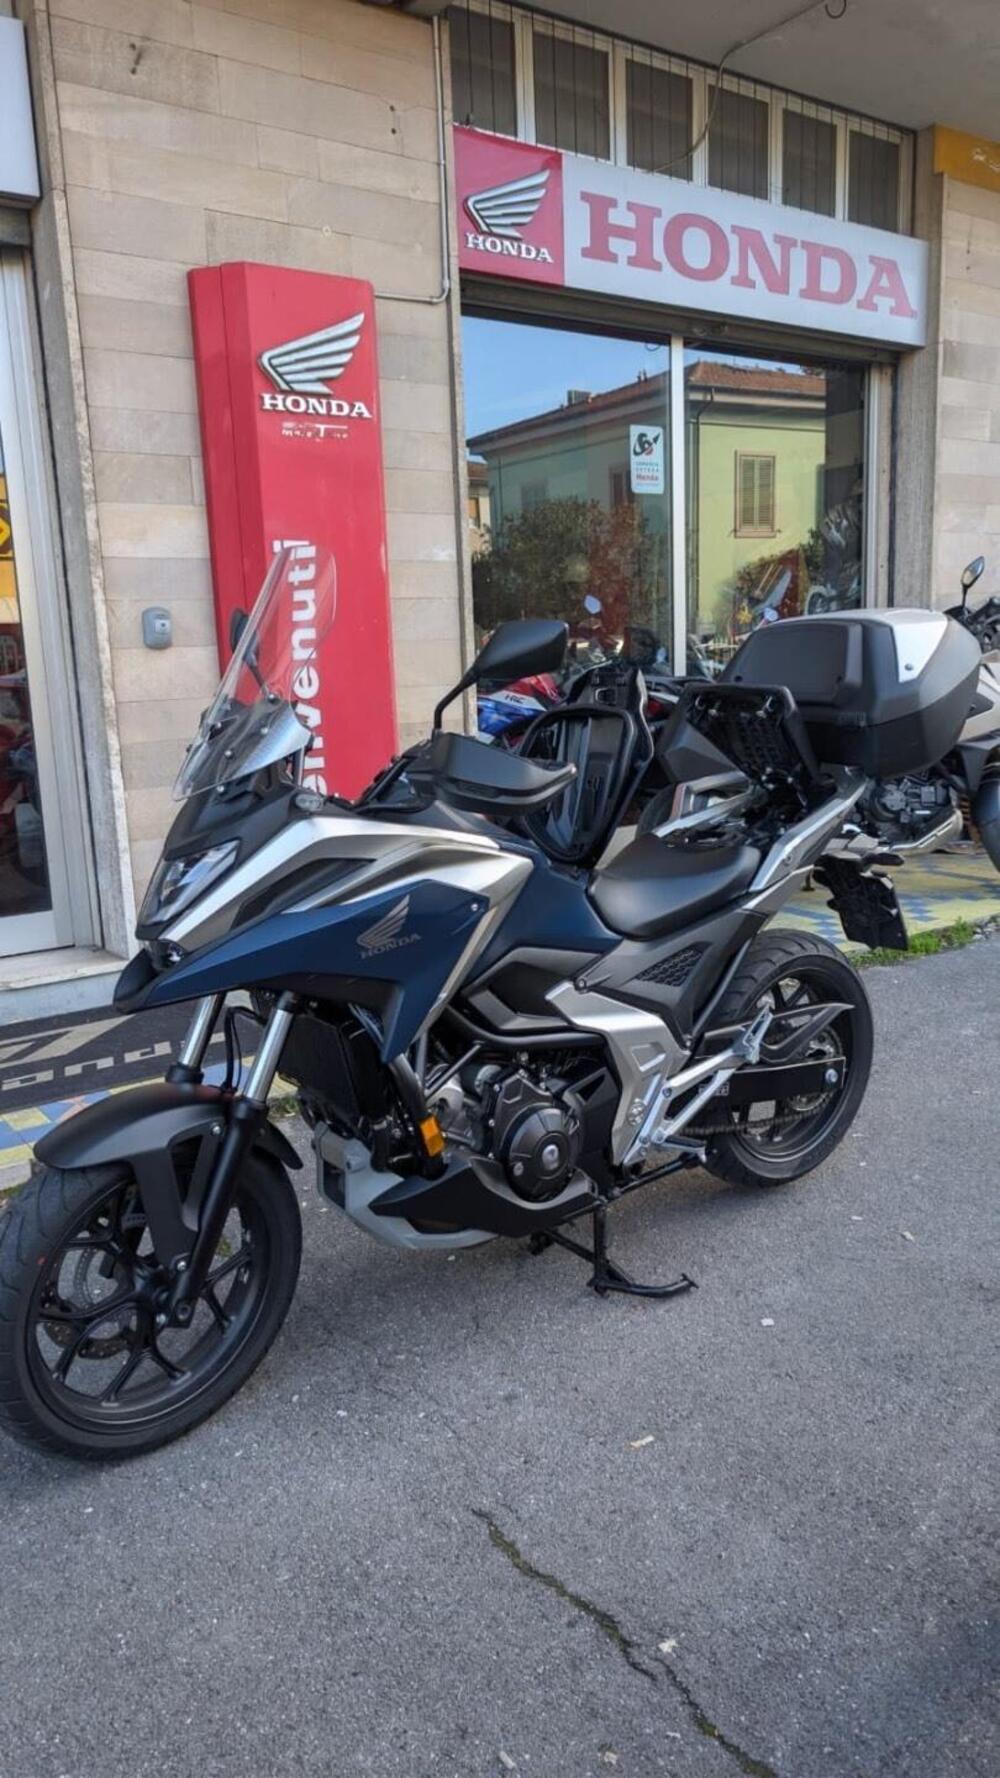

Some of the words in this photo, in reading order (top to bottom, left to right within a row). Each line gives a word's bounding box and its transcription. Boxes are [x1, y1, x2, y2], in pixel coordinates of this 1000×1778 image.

[466, 232, 553, 263] HONDA
[580, 191, 917, 319] HONDA
[261, 393, 373, 418] HONDA
[273, 540, 327, 797] envenuti
[360, 933, 421, 959] HONDA
